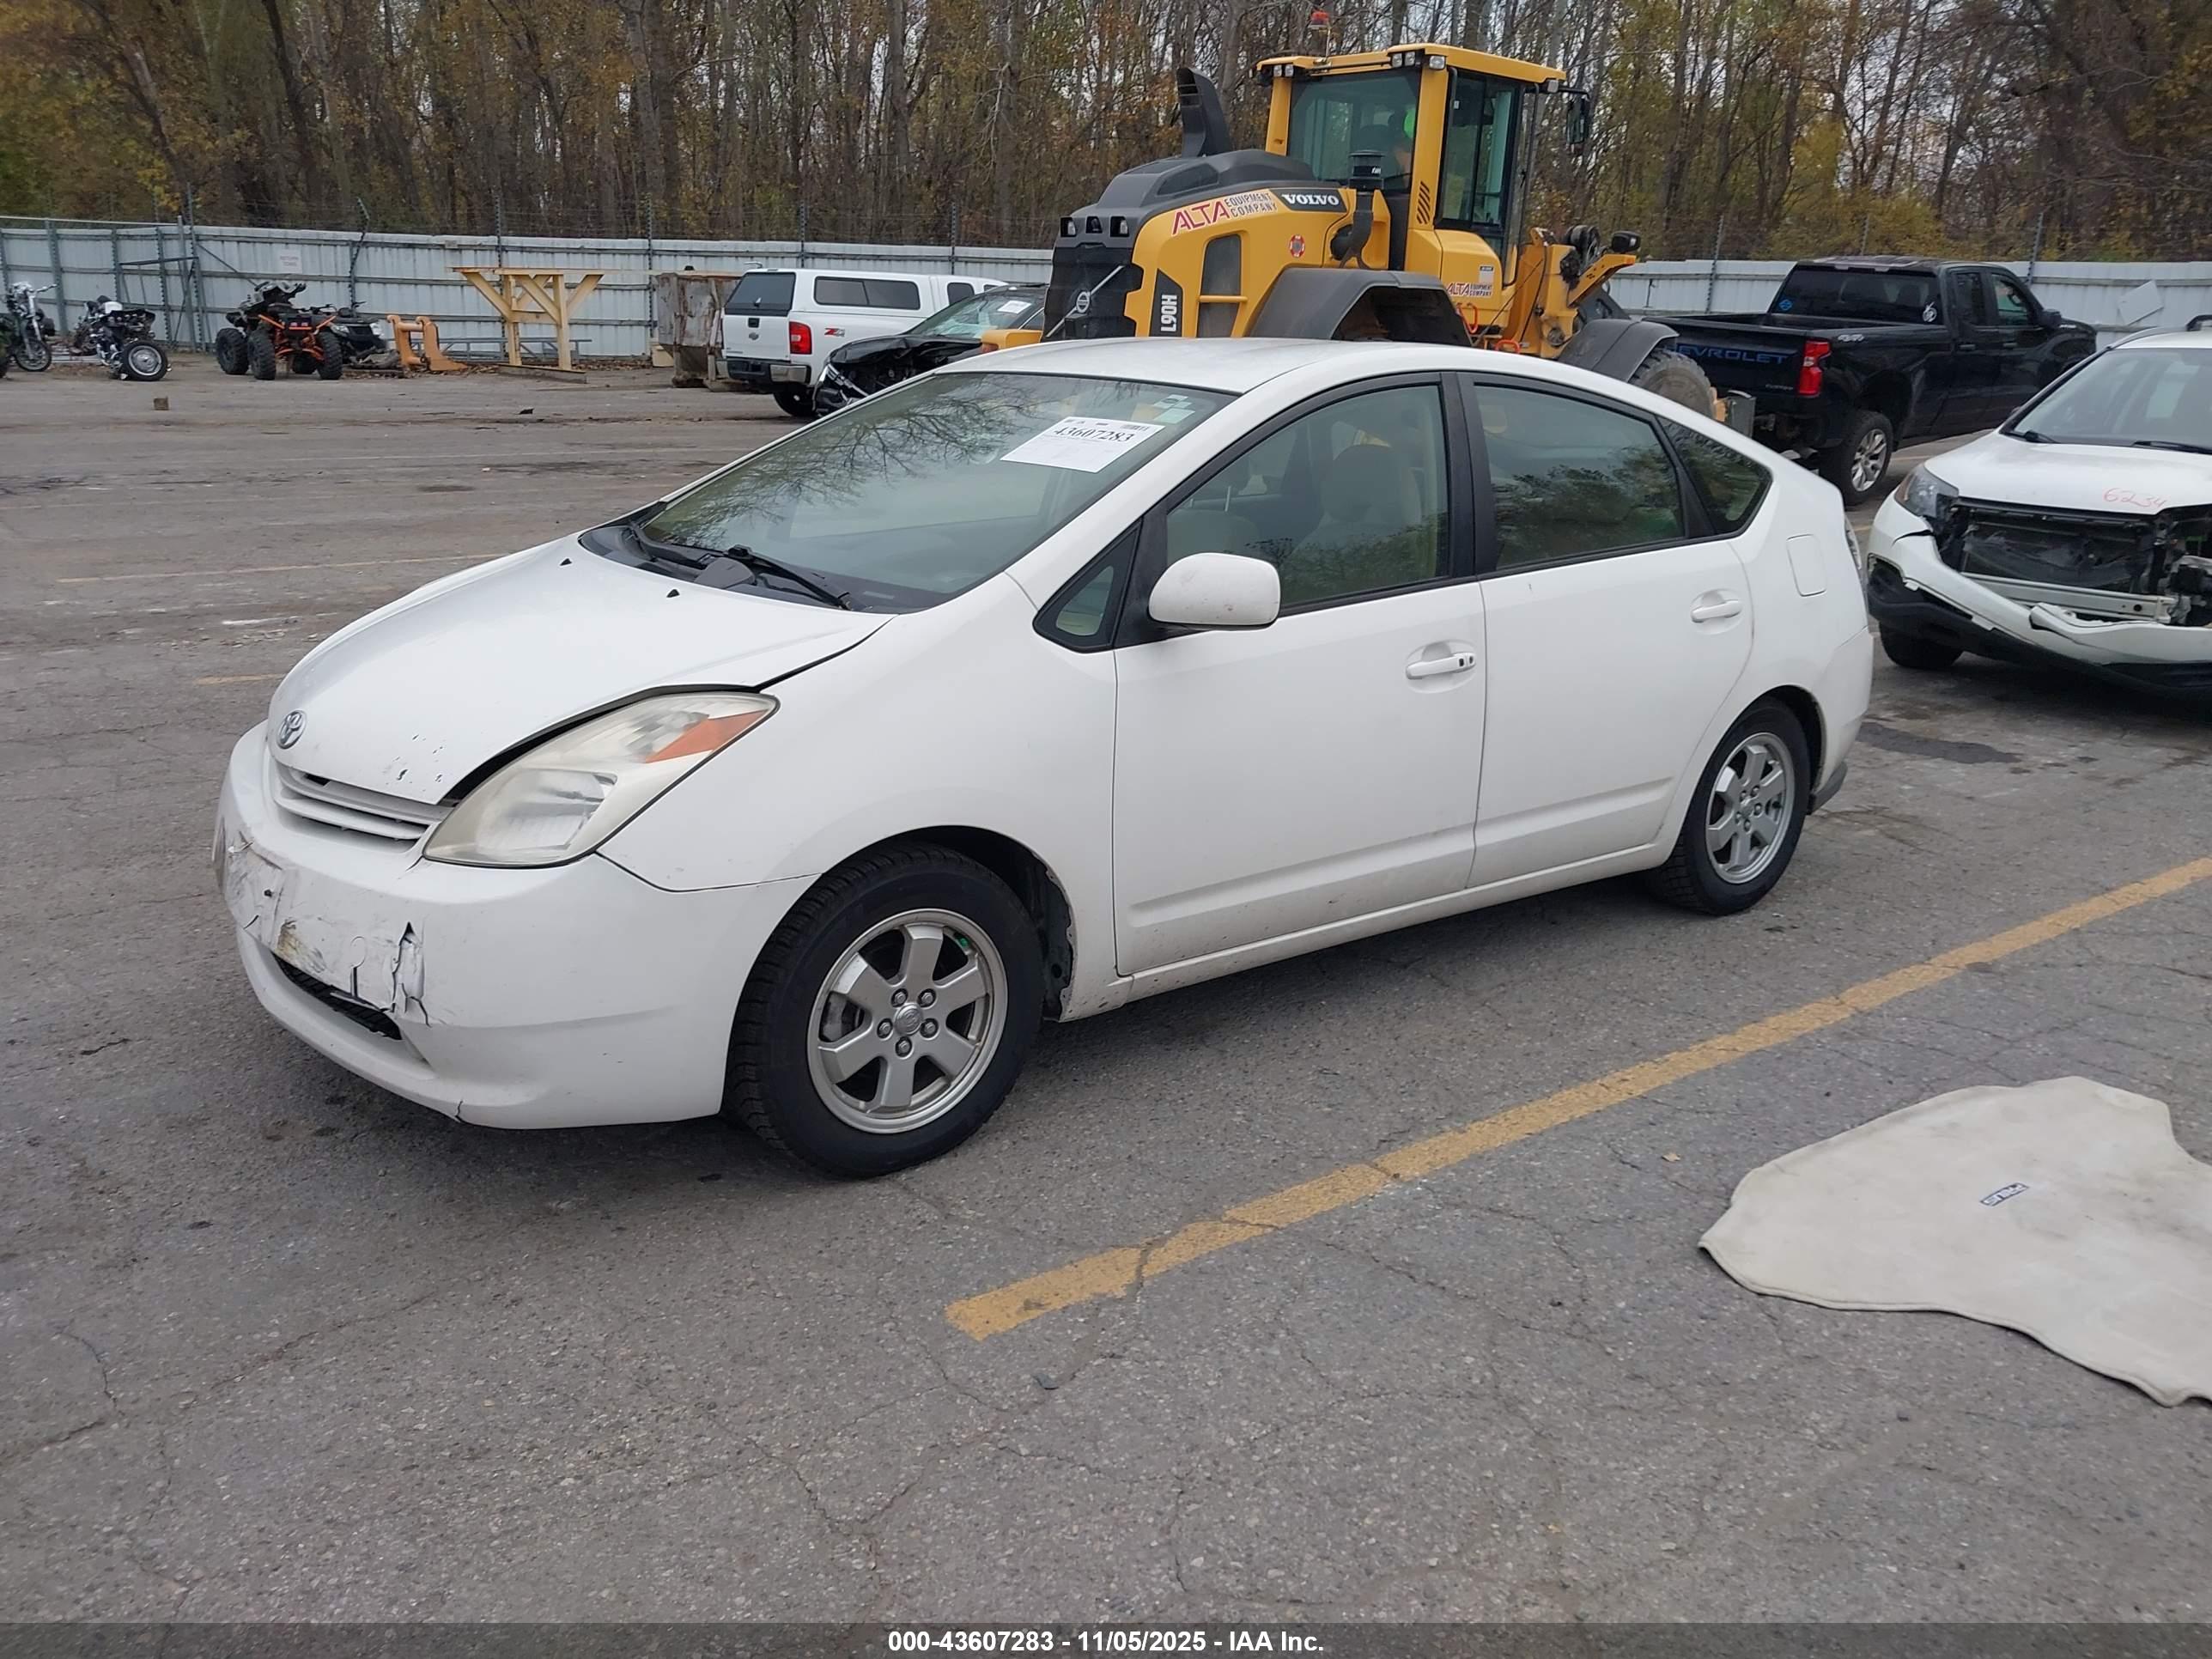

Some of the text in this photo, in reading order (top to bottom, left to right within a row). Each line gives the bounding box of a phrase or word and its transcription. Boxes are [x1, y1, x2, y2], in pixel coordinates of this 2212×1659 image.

[1225, 193, 1271, 207] EQUIPMENT
[1281, 194, 1340, 205] VOLVO
[1173, 201, 1230, 234] ALTA
[1231, 203, 1278, 218] COMPANY
[1446, 283, 1469, 295] ALTA
[1160, 295, 1177, 332] L90H
[1054, 427, 1135, 441] 43607283
